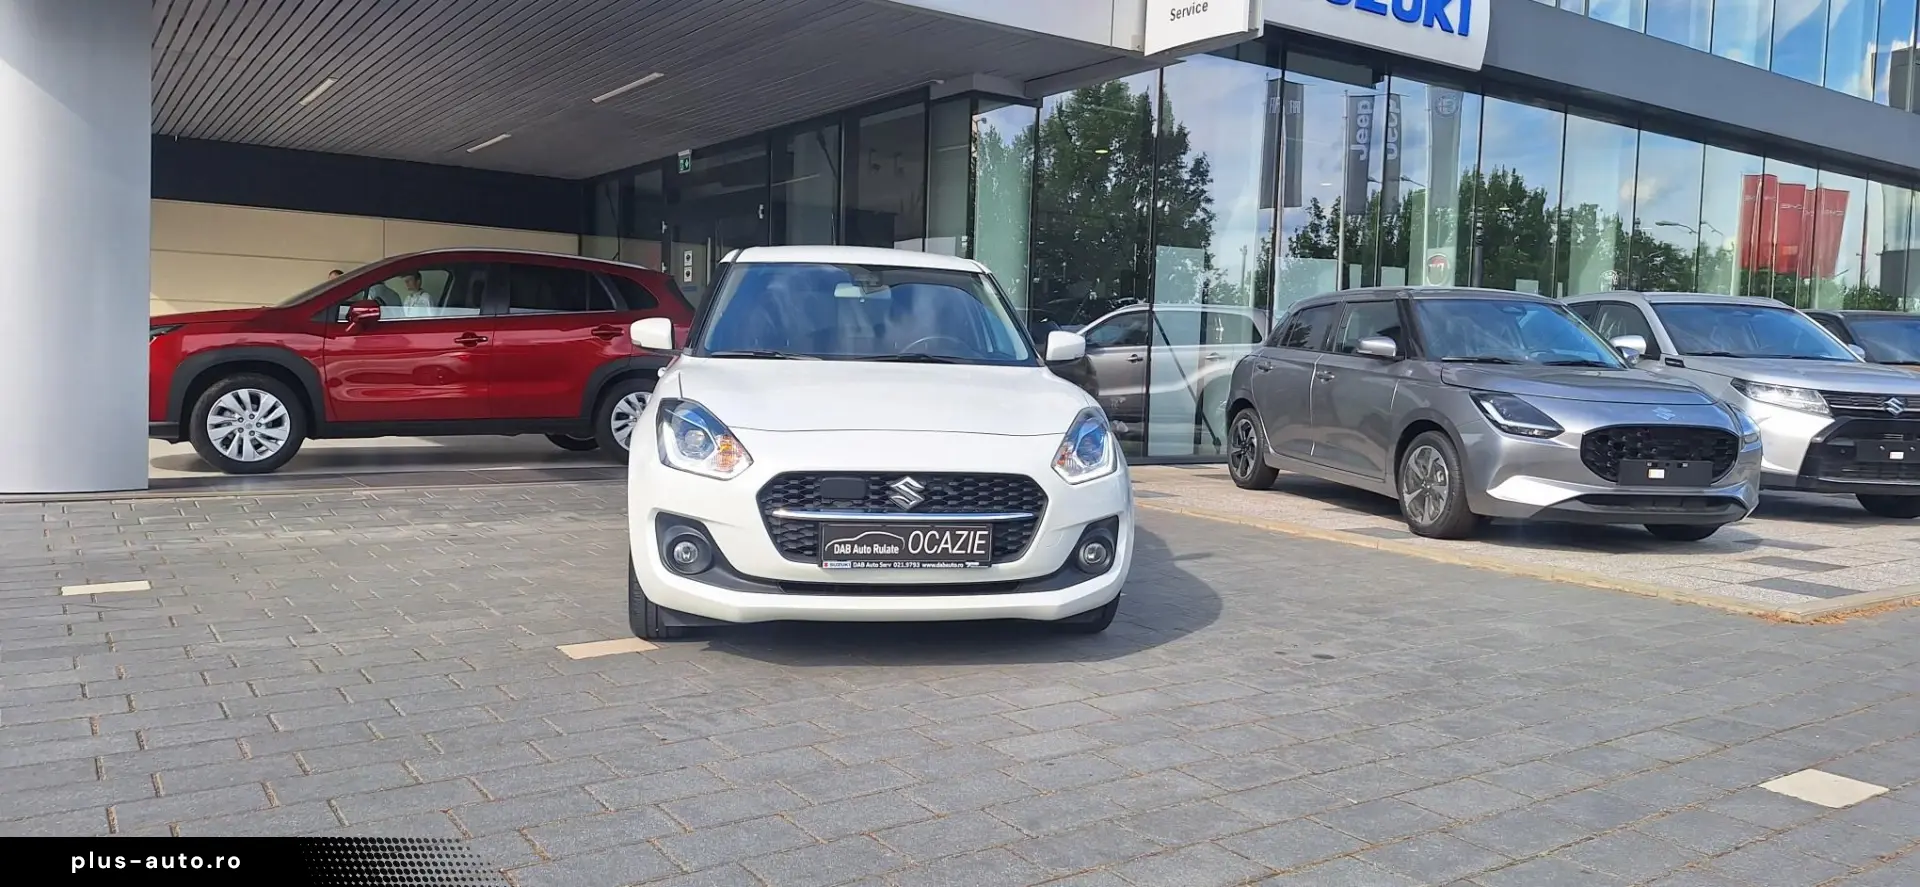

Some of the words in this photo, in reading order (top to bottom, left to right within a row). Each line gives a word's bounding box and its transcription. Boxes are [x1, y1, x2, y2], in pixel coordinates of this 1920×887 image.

[1169, 2, 1209, 22] Service
[1350, 100, 1373, 161] Jeep
[833, 543, 851, 555] DAB
[852, 543, 872, 555] Auto
[873, 543, 900, 555] Rulate
[908, 530, 989, 555] OCAZIE
